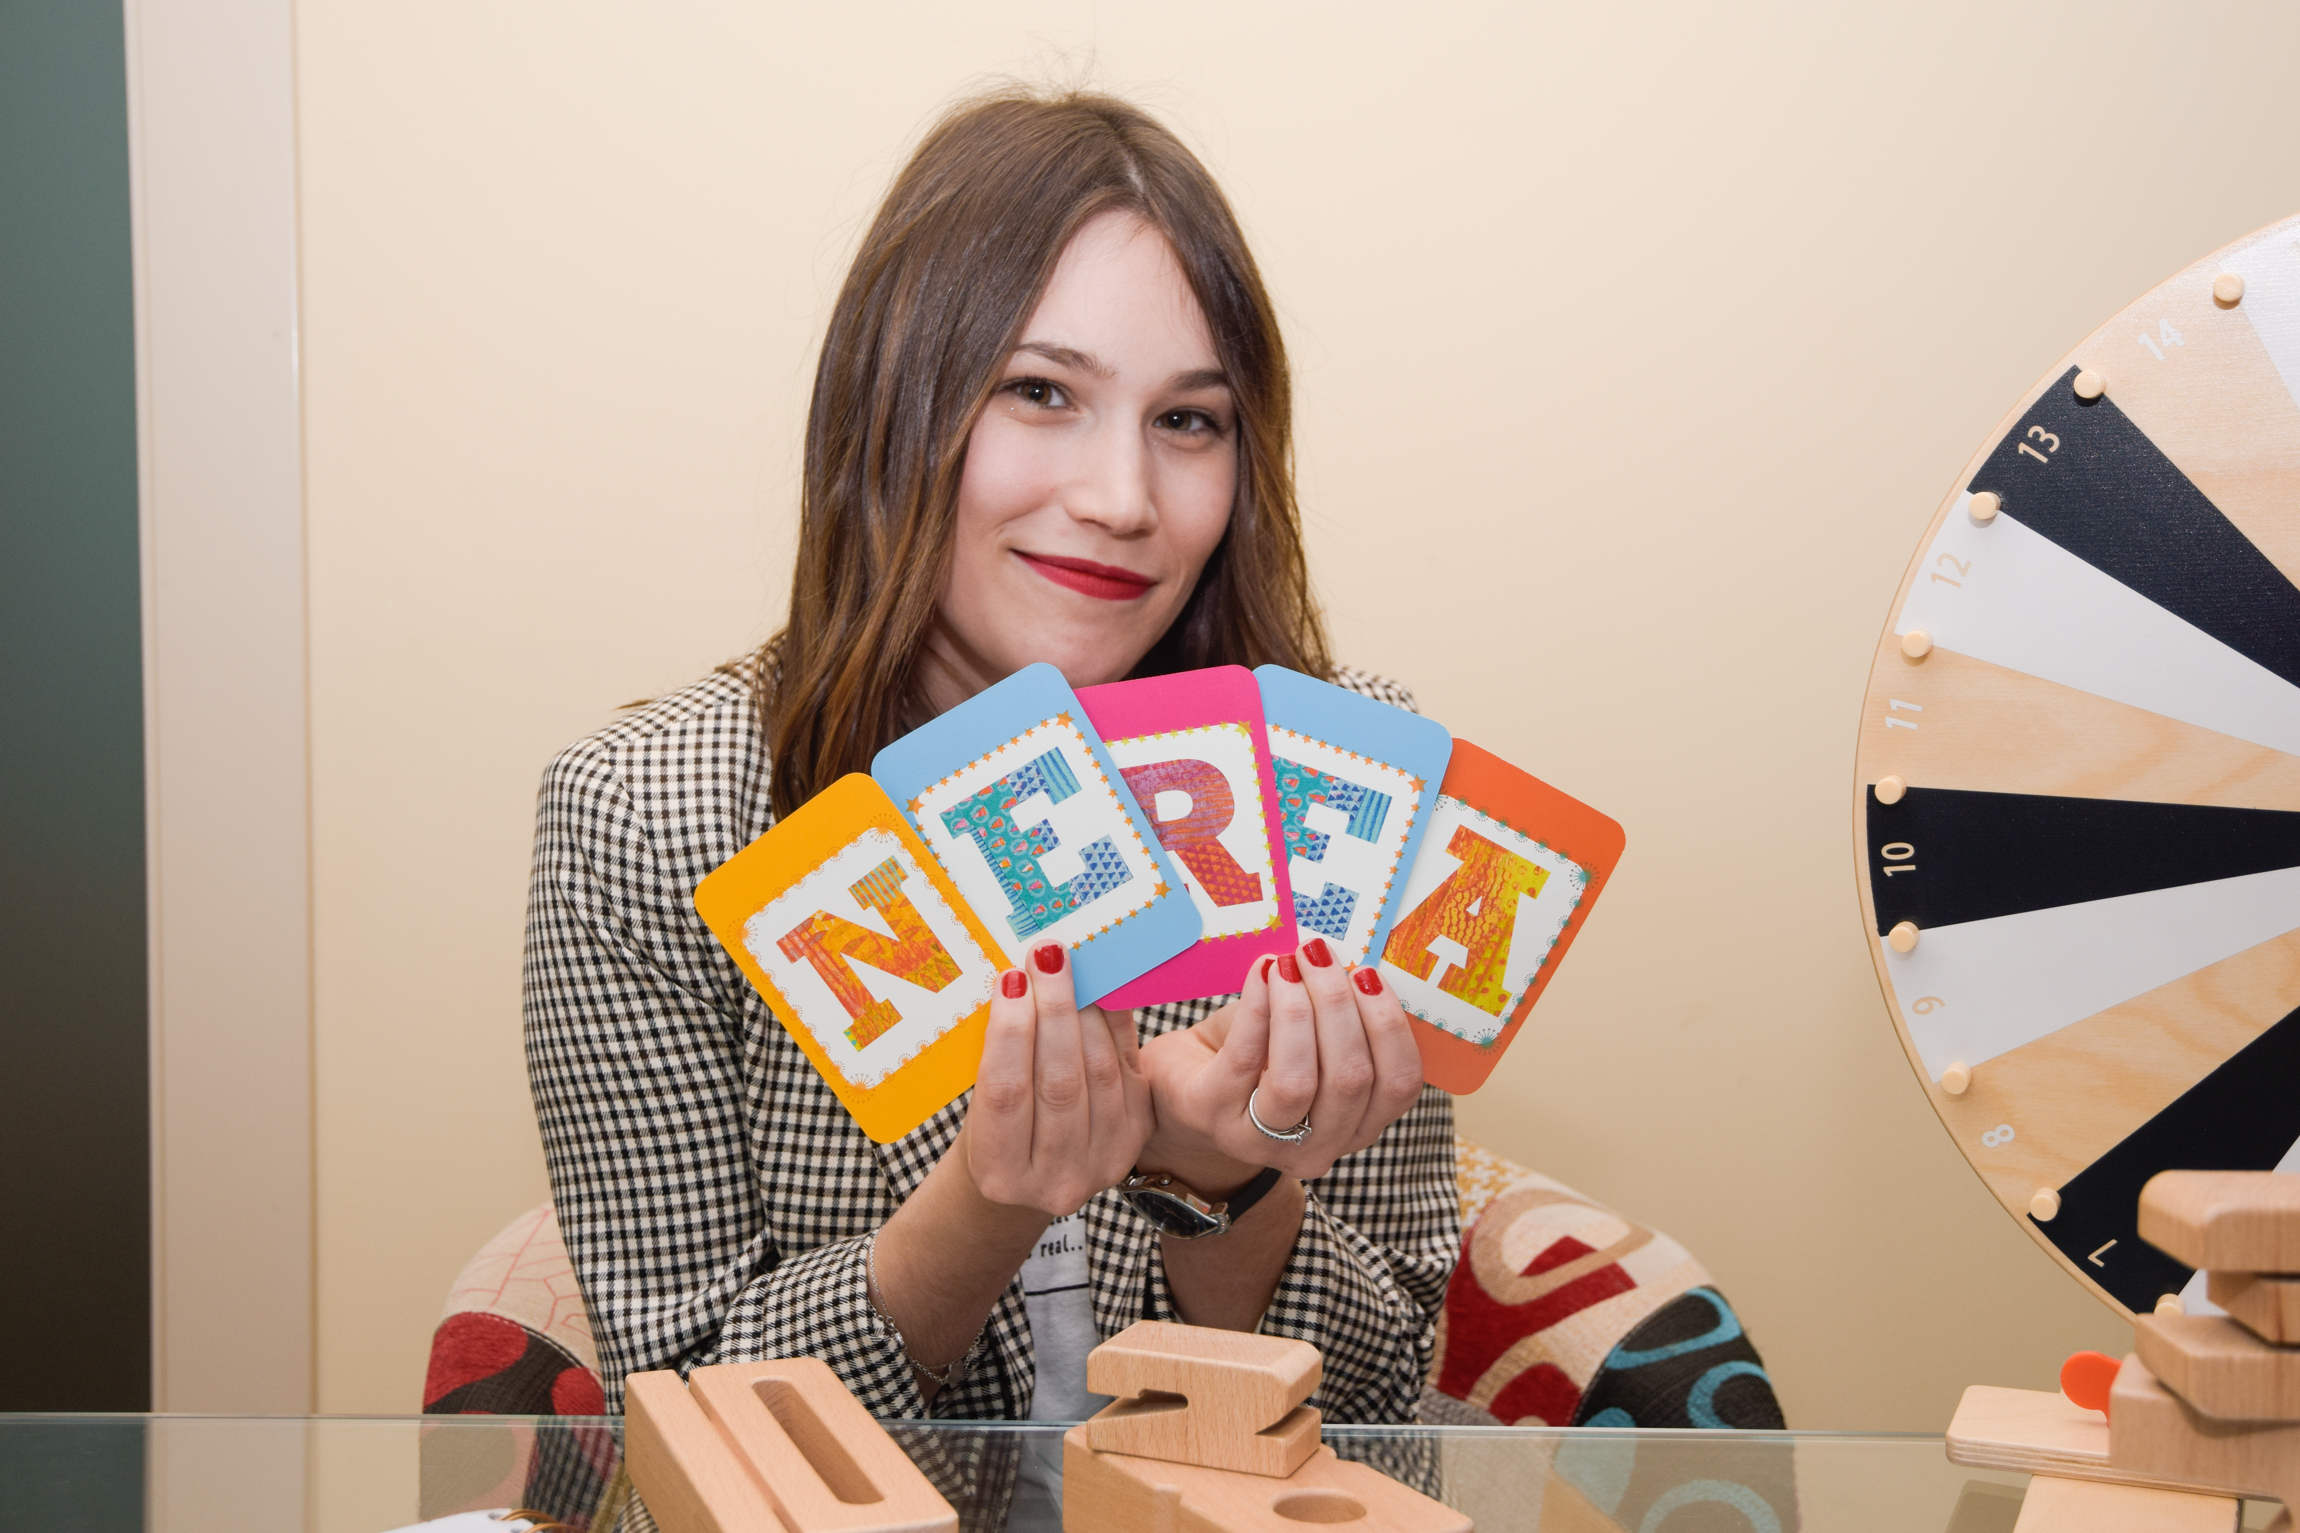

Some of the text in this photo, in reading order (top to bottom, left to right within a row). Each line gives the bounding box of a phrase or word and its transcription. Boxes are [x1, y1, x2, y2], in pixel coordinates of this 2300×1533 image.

[2137, 318, 2185, 361] 14
[2018, 425, 2060, 463] 13
[1930, 553, 1971, 588] 12
[1885, 698, 1923, 730] 11
[1881, 842, 1916, 877] 10
[1911, 996, 1945, 1015] 9
[1981, 1124, 2016, 1148] 8
[2087, 1239, 2118, 1267] 7
